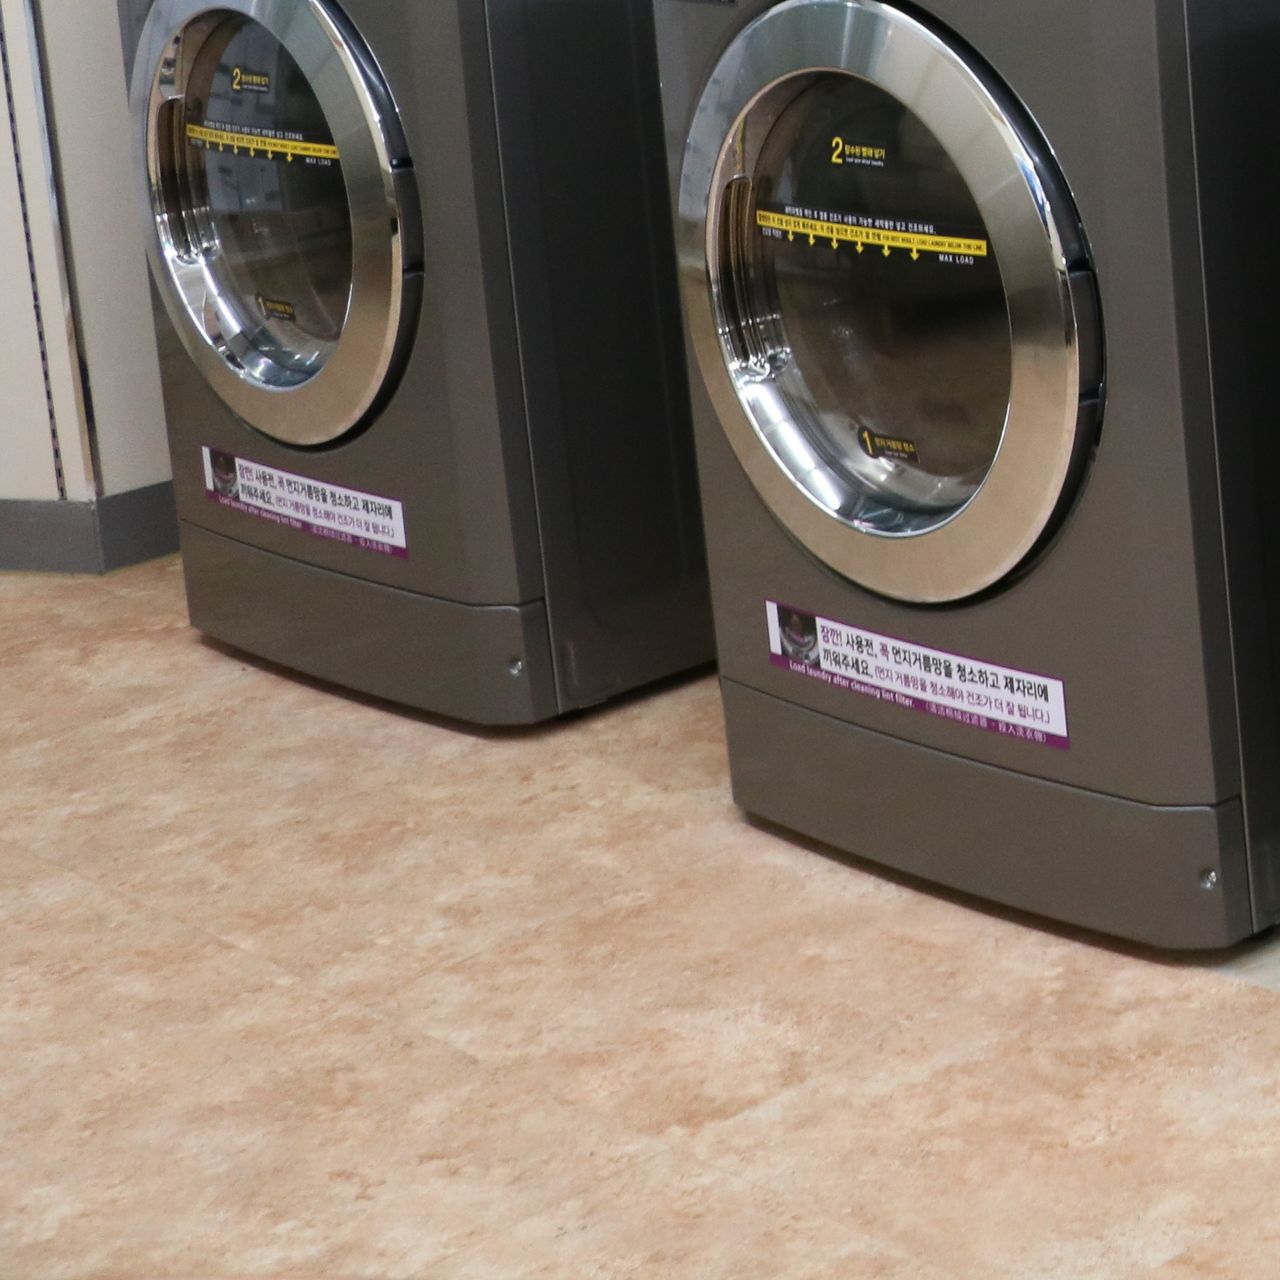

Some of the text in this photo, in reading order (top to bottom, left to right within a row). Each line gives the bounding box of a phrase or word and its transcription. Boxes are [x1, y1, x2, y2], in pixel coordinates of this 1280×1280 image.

[233, 68, 241, 90] 2
[832, 137, 843, 164] 2
[939, 254, 974, 265] MAX LOAD
[863, 431, 873, 454] 1
[821, 625, 842, 646] 잠깐!
[846, 633, 877, 658] 사용전,
[880, 642, 889, 660] 꼭
[957, 663, 1000, 689] 청소하고
[1004, 676, 1049, 702] 제자리에
[823, 648, 873, 678] 끼워주세요.
[789, 660, 805, 673] Load
[807, 666, 832, 682] laundry
[833, 675, 849, 687] after
[851, 681, 881, 698] cleaning
[882, 690, 894, 702] lint
